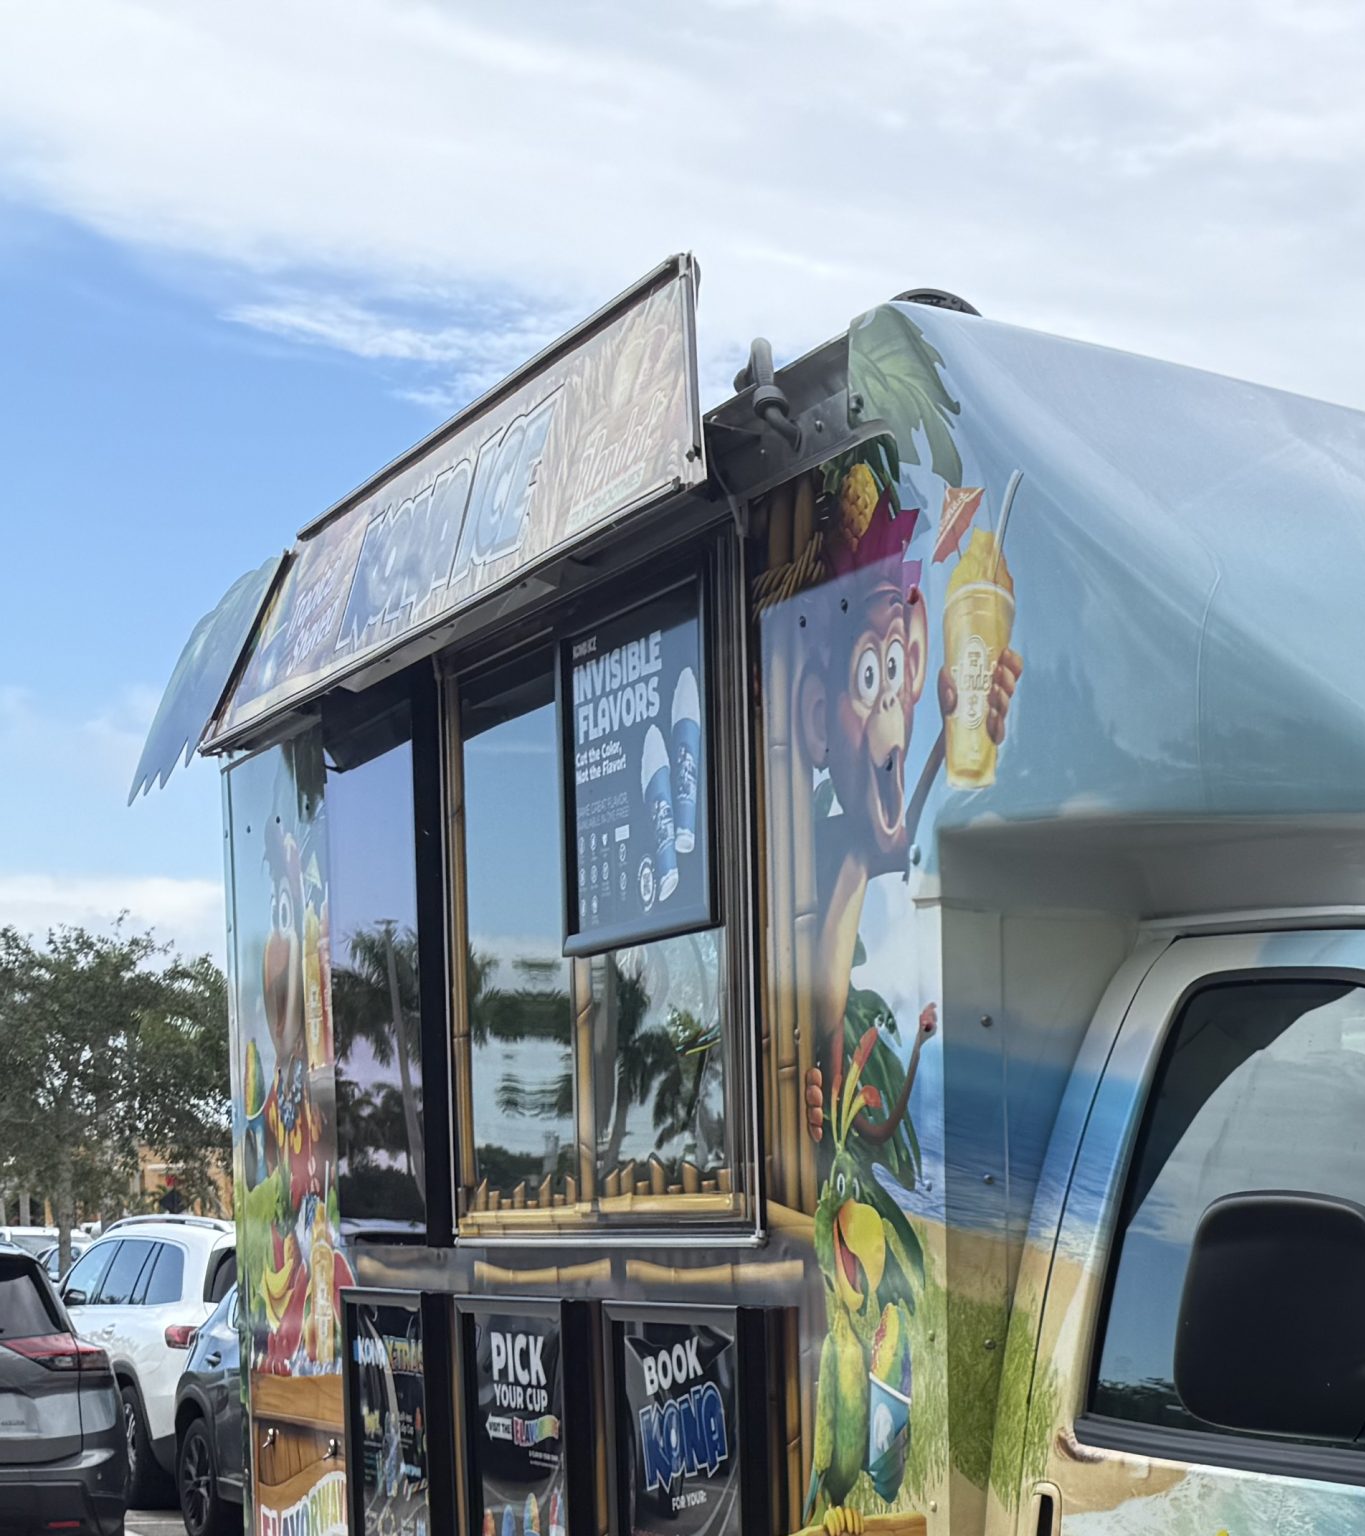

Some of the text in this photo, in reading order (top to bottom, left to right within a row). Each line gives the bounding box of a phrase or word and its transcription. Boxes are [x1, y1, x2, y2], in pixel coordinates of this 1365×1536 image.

[336, 386, 564, 651] KONA ICE
[573, 630, 662, 706] INVISIBLE
[578, 676, 660, 745] FLAVORS
[575, 751, 588, 768] Cut
[589, 747, 601, 763] the
[575, 754, 626, 785] Not the Flavor!
[490, 1332, 547, 1387] PICK
[643, 1336, 703, 1396] BOOK
[494, 1384, 548, 1412] YOUR CUP
[639, 1381, 728, 1494] KONA
[672, 1496, 686, 1512] FOR
